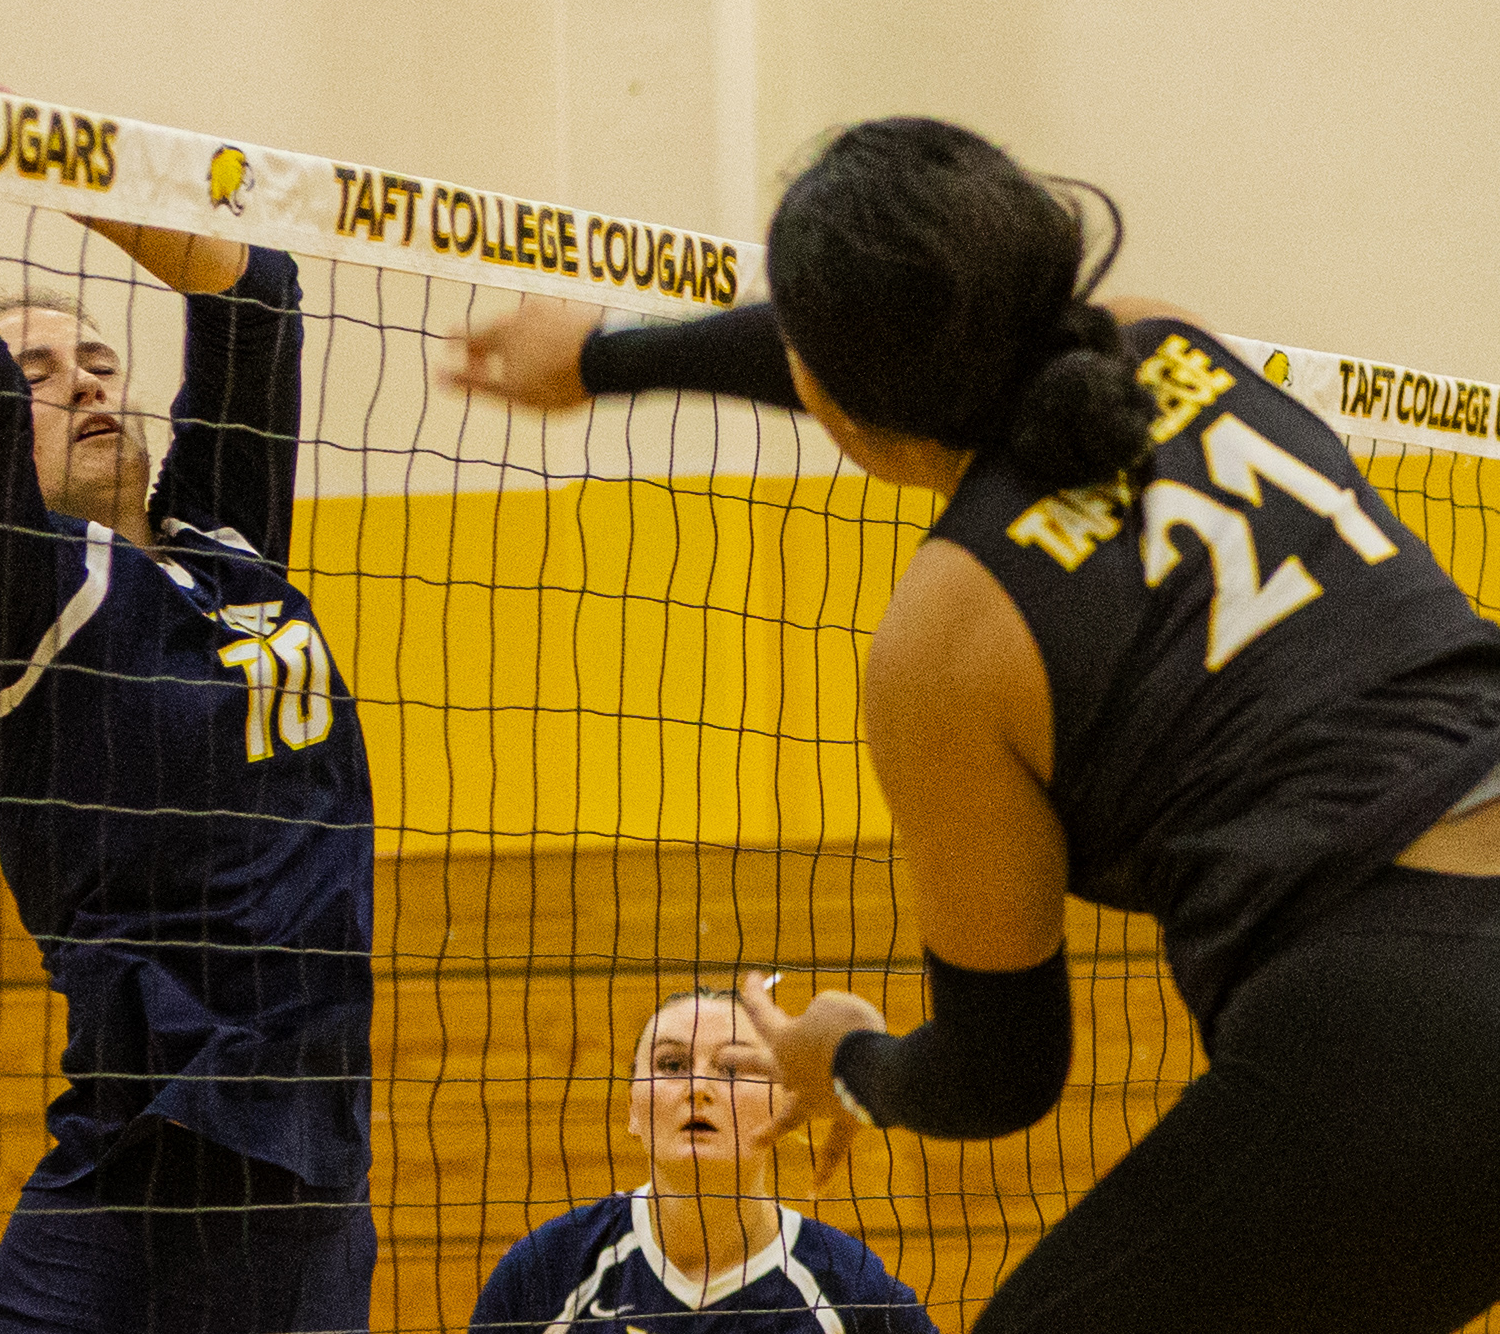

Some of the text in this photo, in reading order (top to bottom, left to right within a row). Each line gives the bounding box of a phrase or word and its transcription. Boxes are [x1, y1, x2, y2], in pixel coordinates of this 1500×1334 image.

[334, 166, 739, 309] TAFT COLLEGE COUGARS
[1339, 360, 1396, 422] TAFT
[1397, 370, 1491, 439] COLLEGE
[1140, 411, 1398, 672] 21
